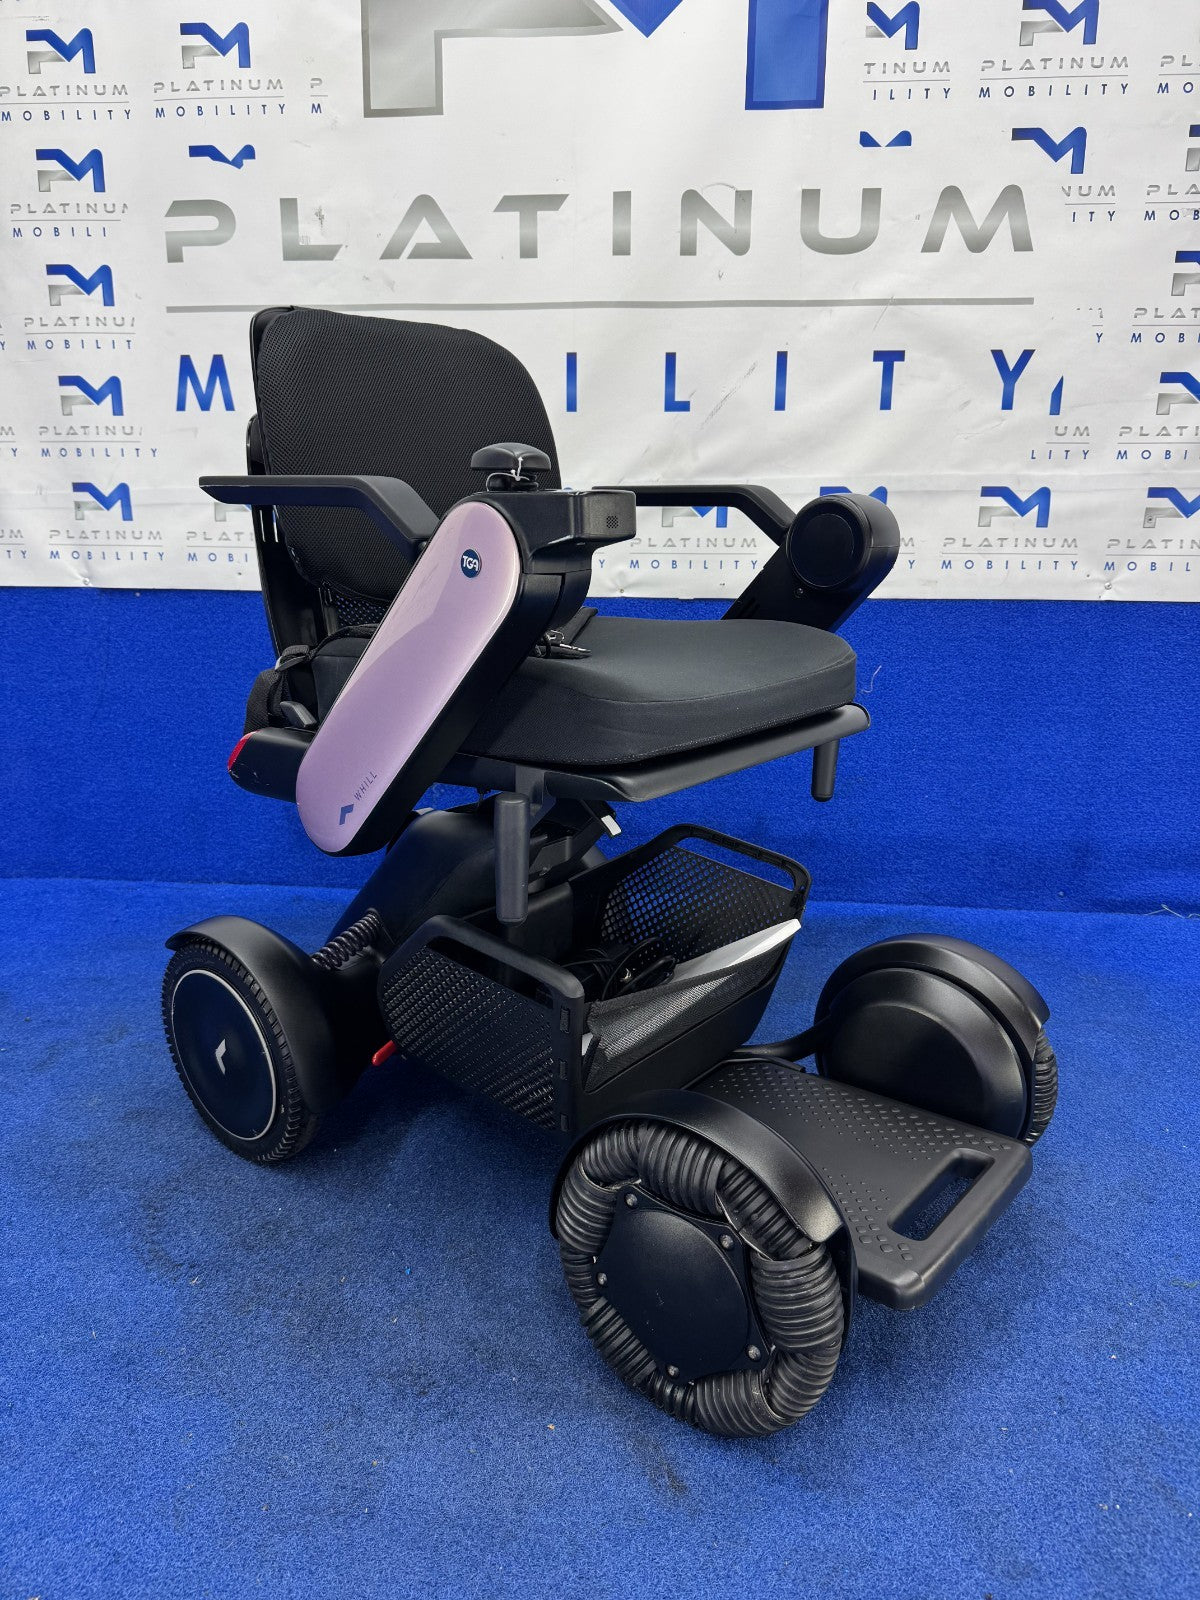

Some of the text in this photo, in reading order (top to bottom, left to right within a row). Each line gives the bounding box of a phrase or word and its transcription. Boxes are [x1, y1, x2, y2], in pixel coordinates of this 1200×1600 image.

[981, 56, 1128, 71] PLATINUM
[0, 85, 128, 97] PLATINUM
[154, 79, 283, 93] PLATINUM
[979, 83, 1128, 98] MOBILITY
[2, 109, 130, 121] MOBILITY
[156, 104, 285, 118] MOBILITY
[165, 184, 1033, 263] PLATINUM
[176, 349, 1036, 413] MILITY
[39, 425, 142, 436] PLATINU
[42, 448, 157, 457] MOBILITY
[50, 530, 162, 540] PLATINUM
[630, 538, 757, 548] PLATINUM
[943, 538, 1078, 548] PLATINUM
[50, 551, 164, 560] MOBILITY
[462, 555, 479, 571] TGA
[630, 560, 757, 569] MOBILITY
[941, 560, 1078, 570] MOBILITY
[354, 771, 378, 801] WHILL
